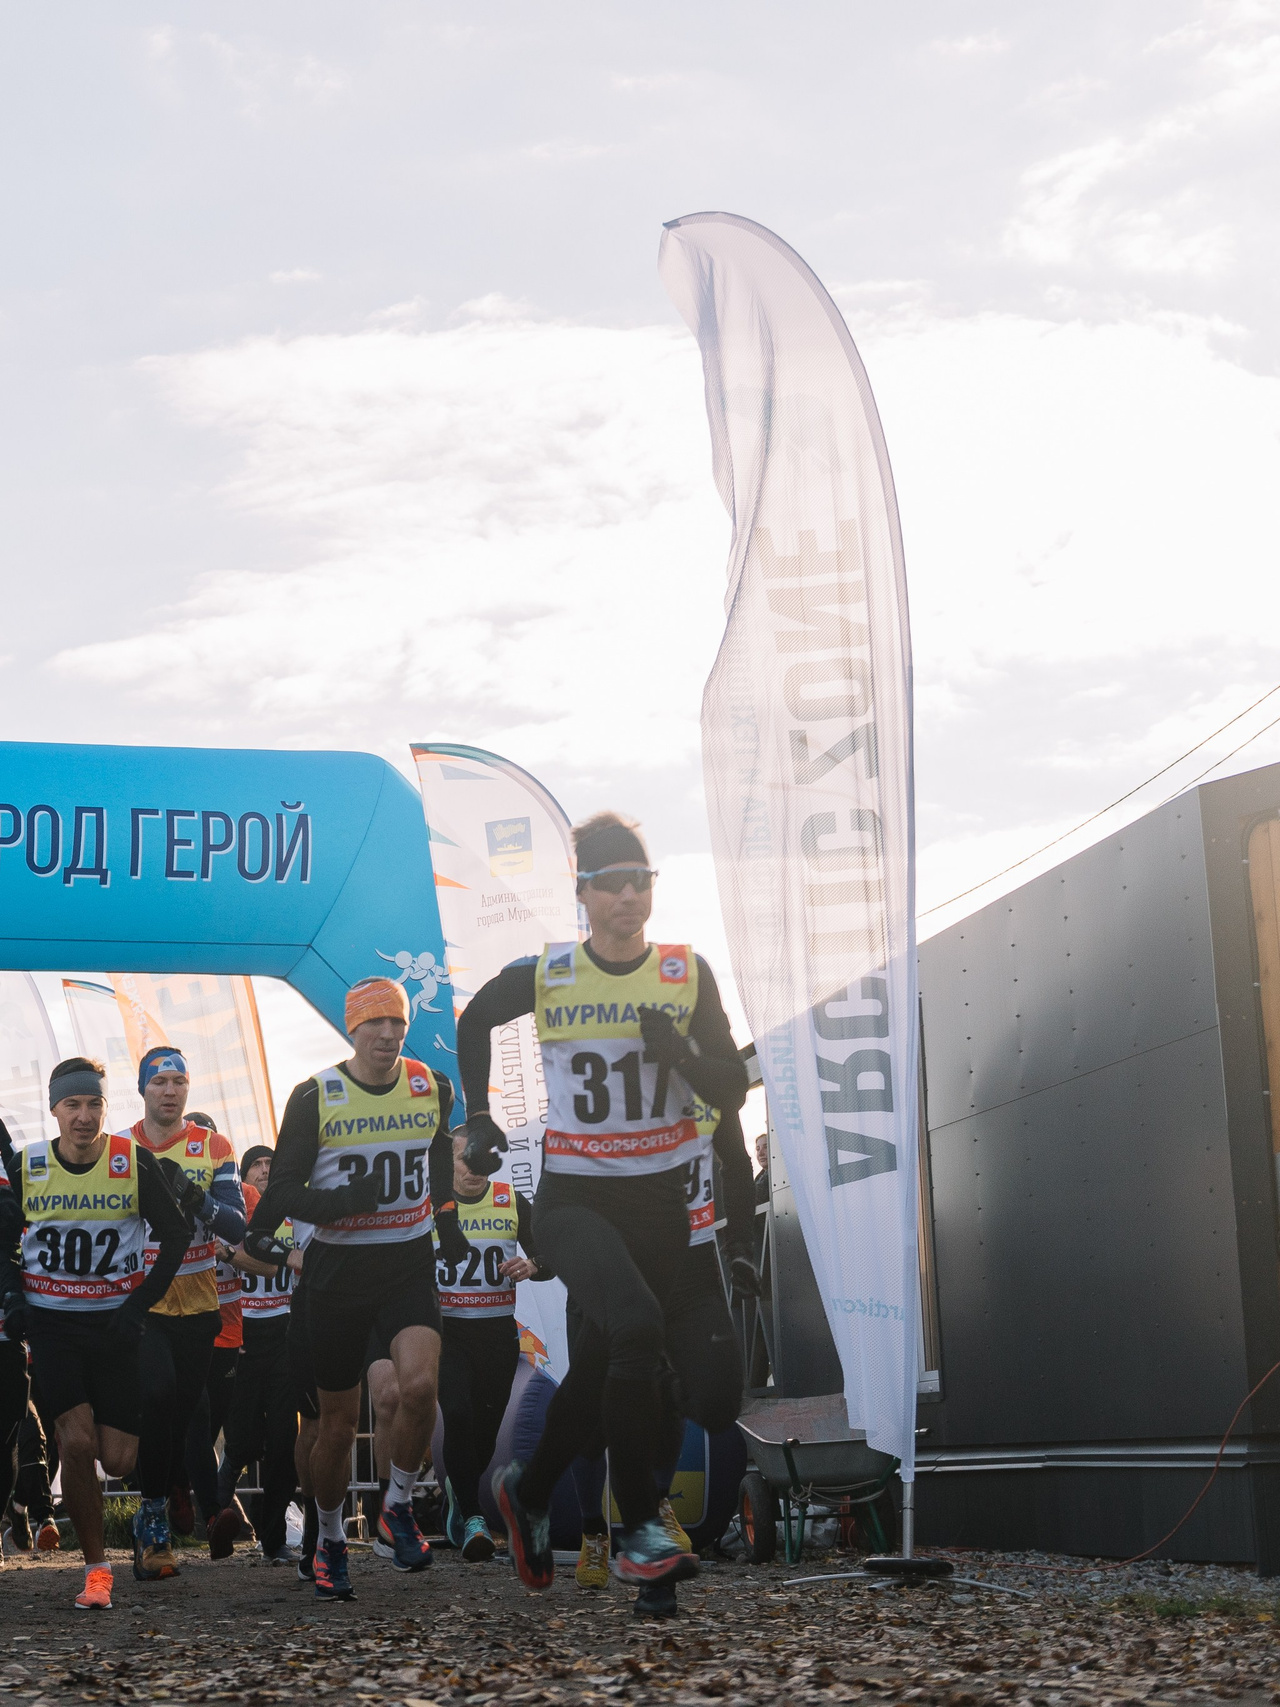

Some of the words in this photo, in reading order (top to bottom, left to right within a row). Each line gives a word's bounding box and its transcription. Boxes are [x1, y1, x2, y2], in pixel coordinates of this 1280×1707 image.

[130, 800, 311, 883] ГЕРОЙ
[481, 888, 554, 908] Администрация
[477, 911, 505, 928] города
[507, 907, 561, 922] Мурманска
[499, 1020, 528, 1129] культуре
[571, 1051, 670, 1124] 317
[325, 1111, 435, 1138] МУРМАНСК
[27, 1194, 134, 1212] МУРМАНСК
[458, 1218, 513, 1232] МАНСК
[36, 1227, 121, 1277] 302
[435, 1246, 505, 1287] 320
